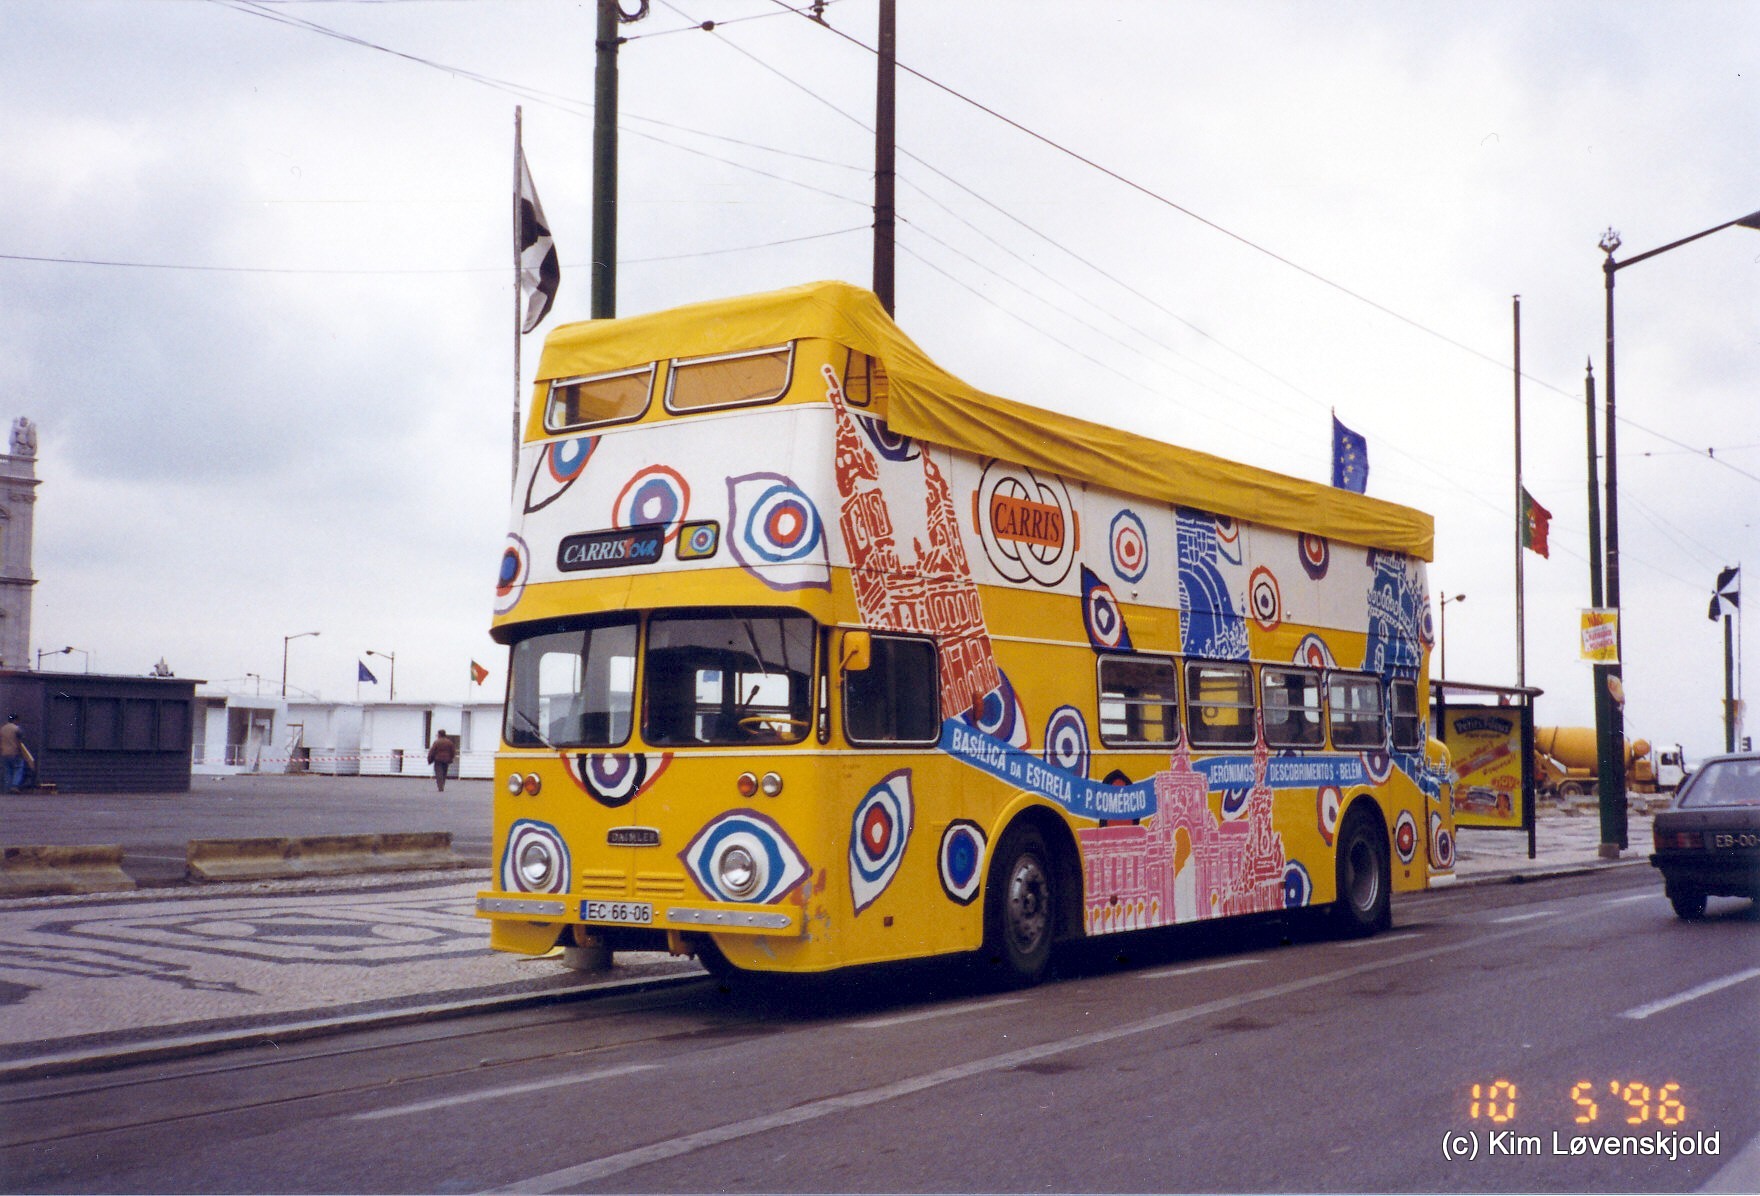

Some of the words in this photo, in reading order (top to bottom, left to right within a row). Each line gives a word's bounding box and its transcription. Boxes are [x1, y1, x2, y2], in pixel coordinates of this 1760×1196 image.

[994, 502, 1060, 543] CARRIS
[952, 728, 1006, 772] BASÍLICA
[1010, 762, 1022, 779] DA
[1026, 763, 1071, 803] ESTRELA
[1085, 788, 1094, 809] P.
[1096, 789, 1146, 814] COMÉRCIO
[1208, 760, 1255, 784] JERÓNIMOS
[1270, 763, 1334, 781] DESCOBRIMENTOS
[1339, 760, 1363, 780] BELÉM
[611, 831, 657, 843] DAIMLER
